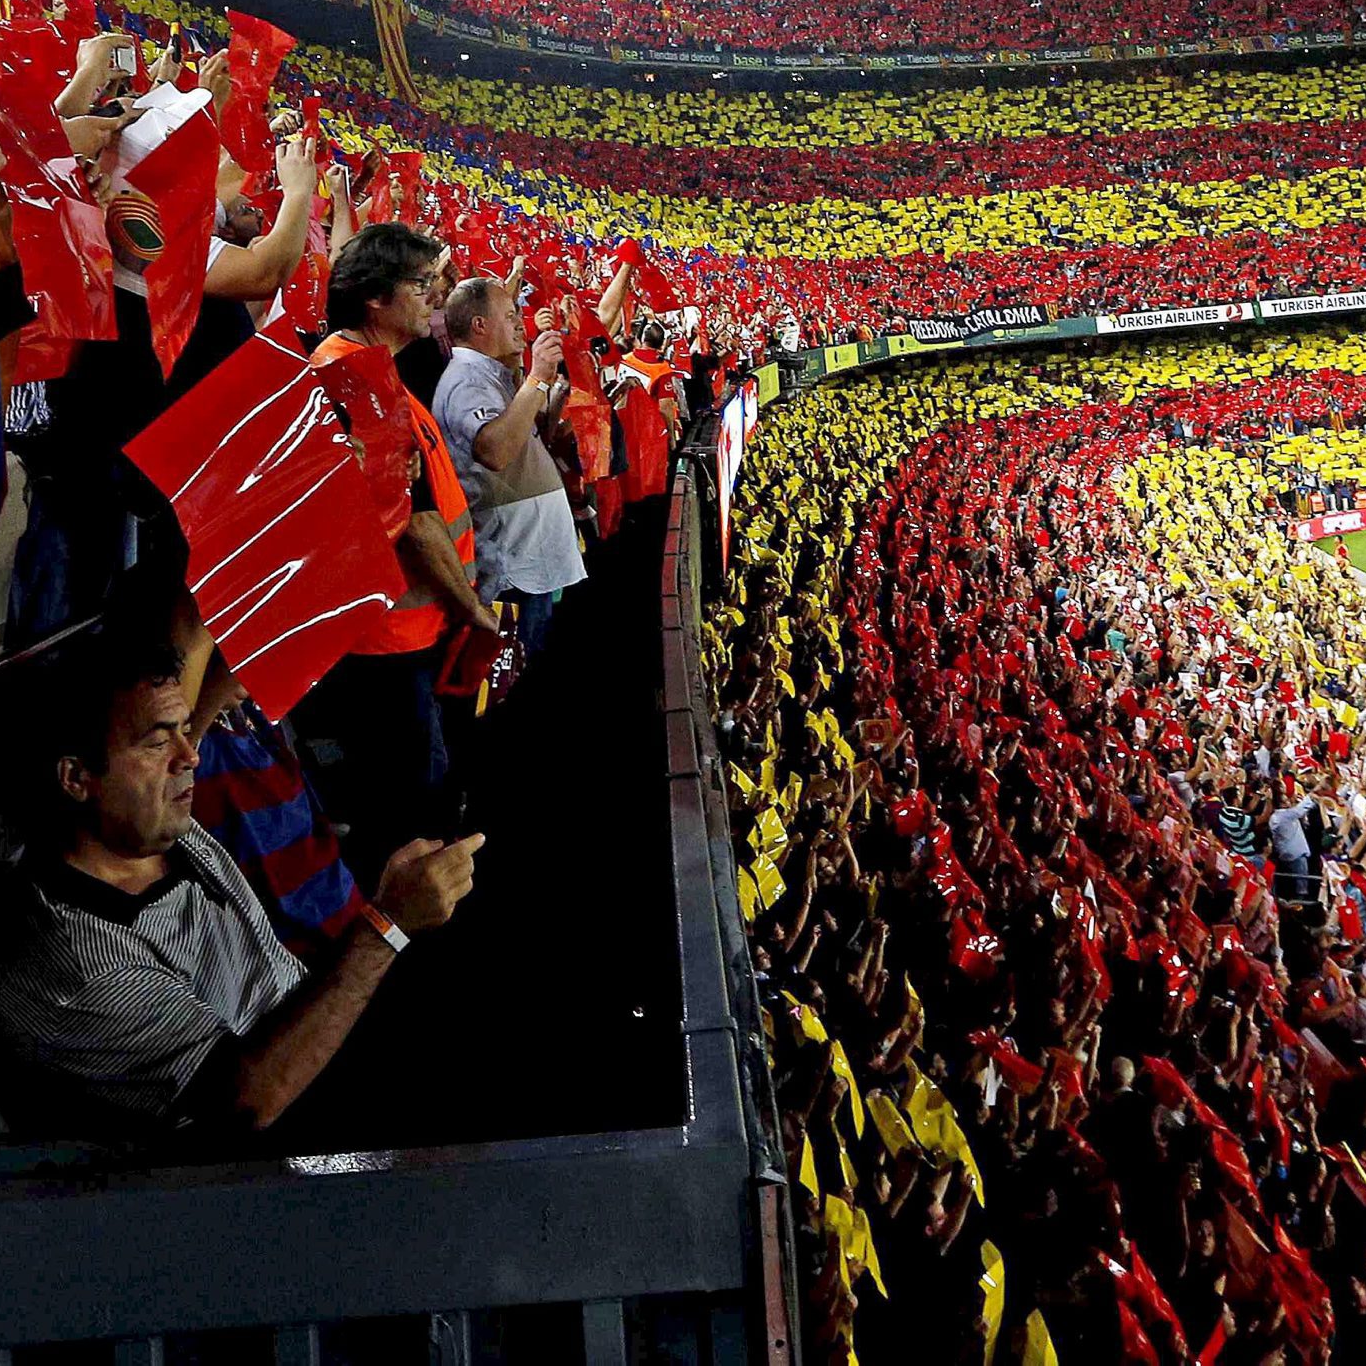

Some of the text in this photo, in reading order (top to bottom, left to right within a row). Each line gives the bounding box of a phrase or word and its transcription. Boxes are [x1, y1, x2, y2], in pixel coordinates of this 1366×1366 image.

[1271, 296, 1323, 313] TURKISH
[909, 319, 959, 340] FREEDOM
[965, 306, 1043, 333] CATALONIA
[1112, 308, 1220, 330] TURKISH AIRLINES
